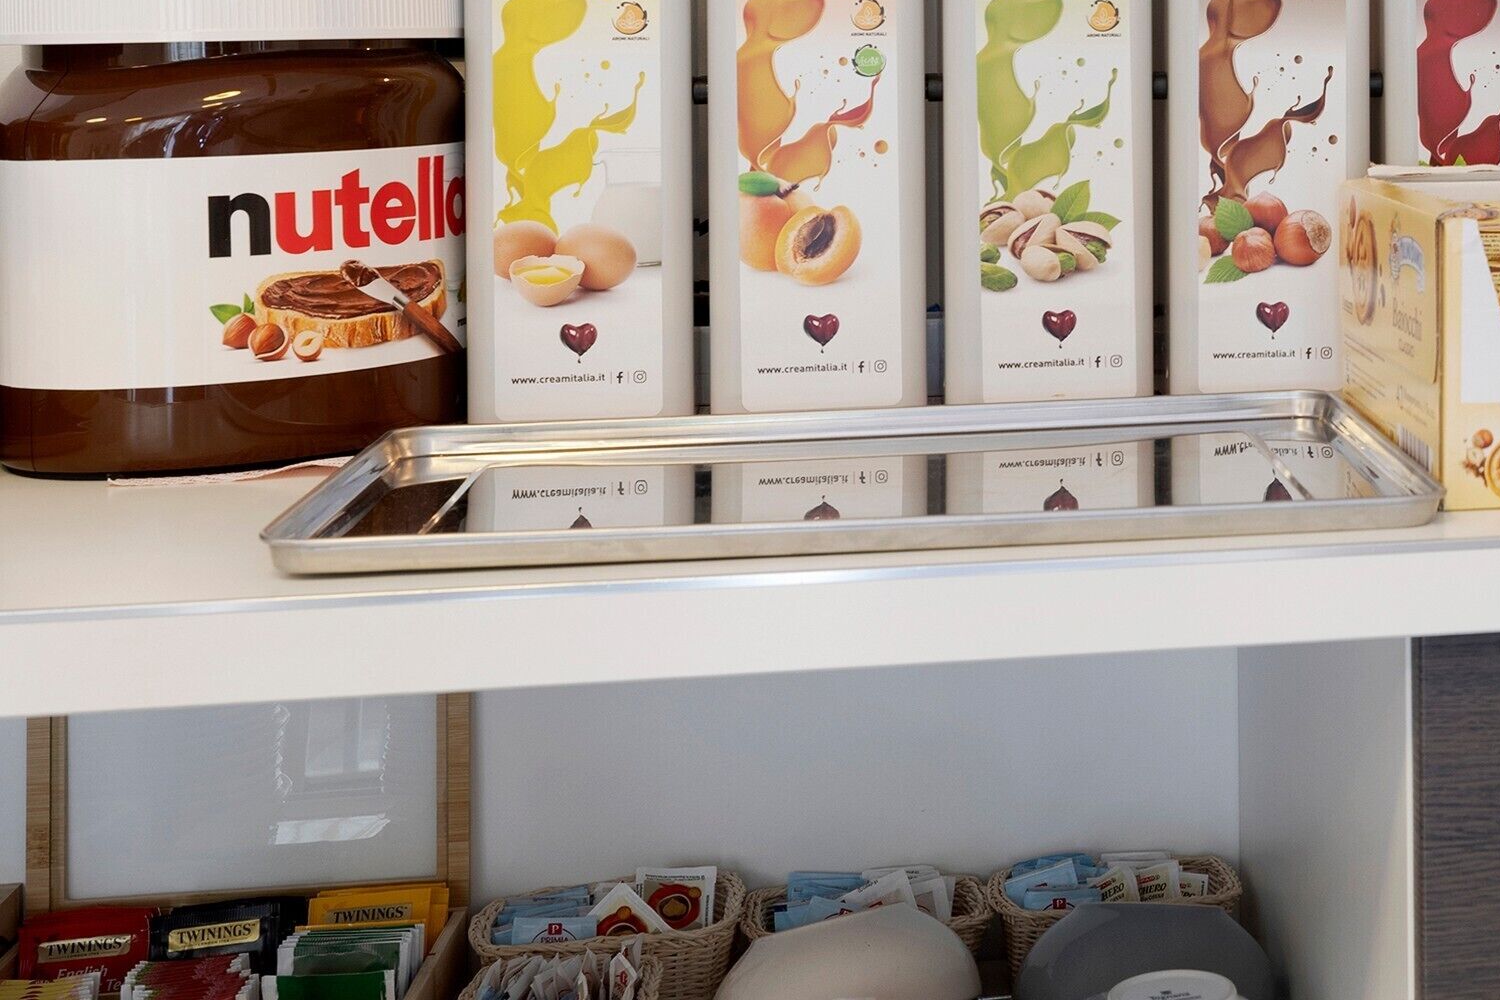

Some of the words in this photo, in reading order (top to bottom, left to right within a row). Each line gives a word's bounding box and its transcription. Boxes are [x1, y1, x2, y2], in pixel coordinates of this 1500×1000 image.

[208, 155, 467, 258] nutella
[1212, 348, 1296, 361] www.creamitalia.it
[757, 362, 848, 375] www.creamitalia.it
[998, 356, 1085, 370] www.creamitalia.it
[511, 373, 606, 385] www.creamitalia.it
[333, 905, 405, 924] TWININGS
[178, 924, 252, 945] TWININGS
[46, 936, 122, 957] TWININGS
